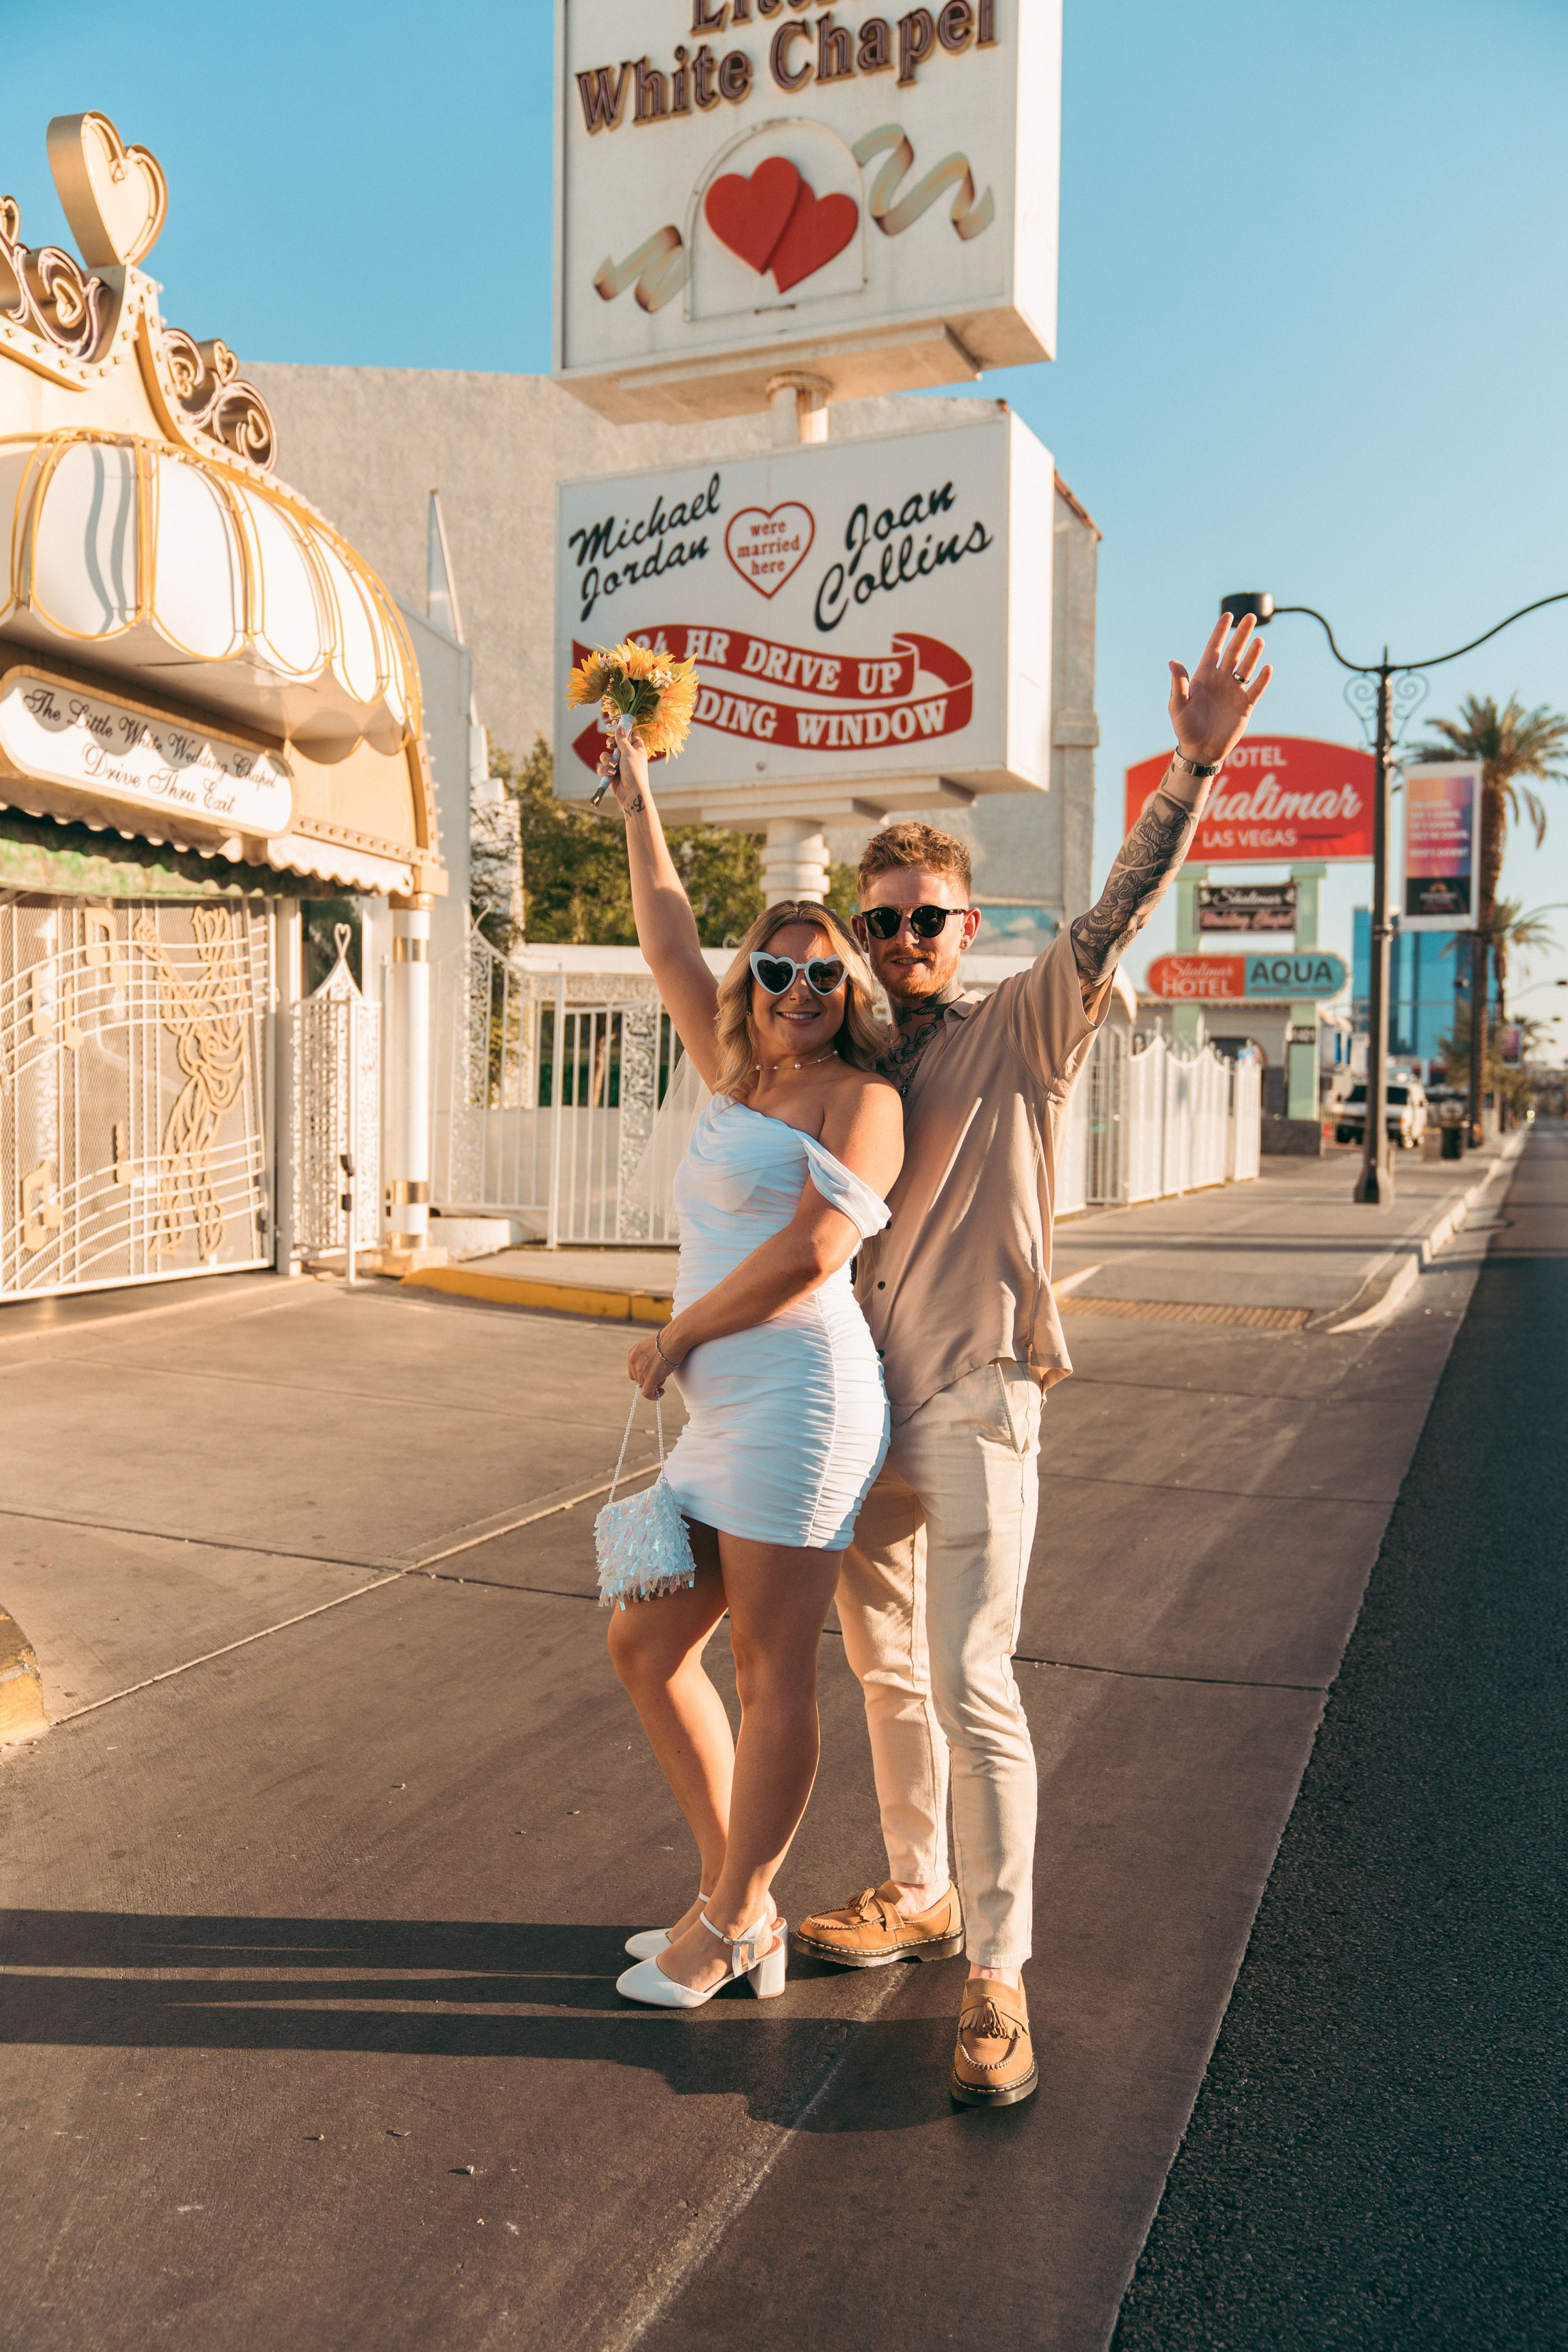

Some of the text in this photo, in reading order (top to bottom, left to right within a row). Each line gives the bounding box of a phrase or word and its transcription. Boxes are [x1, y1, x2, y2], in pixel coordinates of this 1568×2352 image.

[575, 0, 998, 136] White Chapel
[568, 472, 720, 567] Michael
[750, 521, 785, 536] were
[845, 481, 956, 577] Joan
[738, 534, 800, 558] married
[751, 559, 785, 575] here
[580, 535, 709, 622] Jordan
[815, 521, 994, 631] Collins
[684, 629, 730, 664] HR
[742, 640, 842, 691] DRIVE
[858, 661, 902, 694] UP
[23, 688, 277, 792] The Little White Wedding Chapel
[693, 689, 948, 746] DING WINDOW
[82, 743, 236, 813] Drive Thru Exit
[1226, 746, 1288, 768] OTEL
[1142, 773, 1363, 821] halimar
[1202, 828, 1297, 847] LAS VEGAS
[1162, 957, 1234, 976] Shalimar
[1162, 978, 1234, 996] HOTEL
[1251, 961, 1334, 985] AQUA
